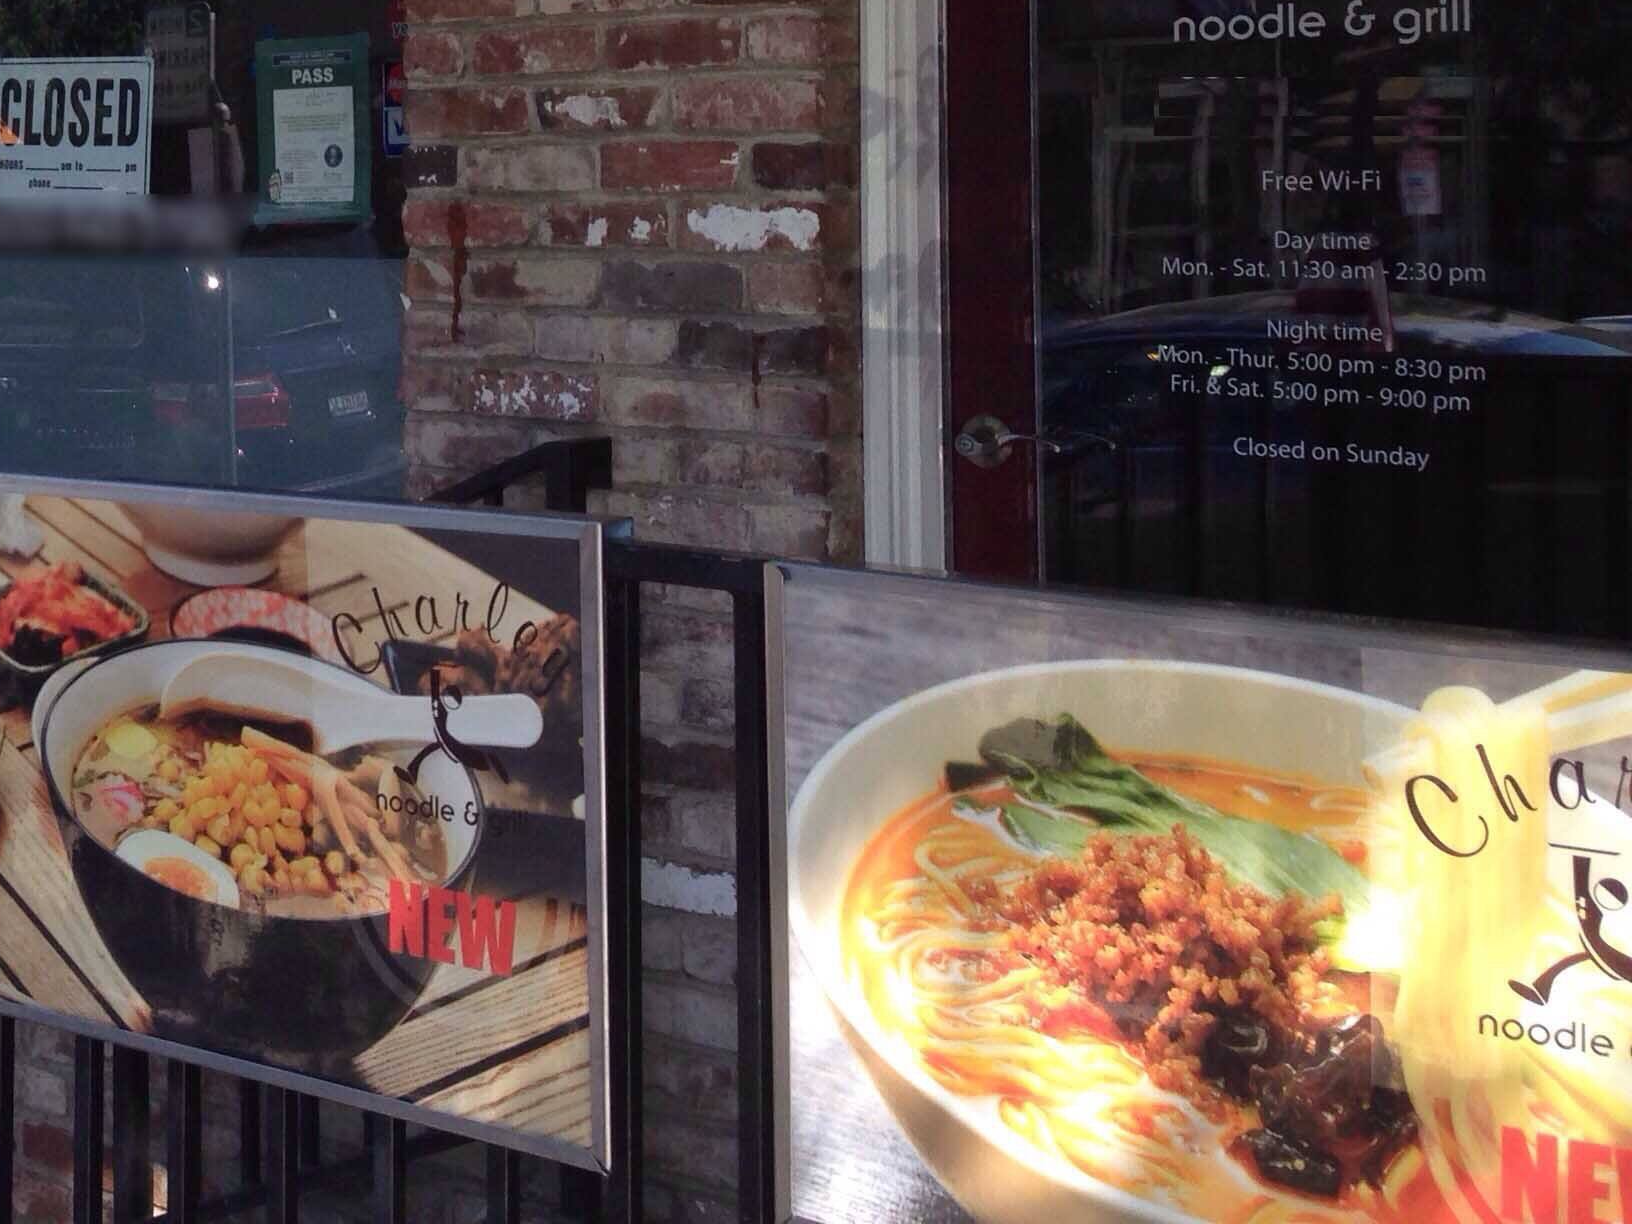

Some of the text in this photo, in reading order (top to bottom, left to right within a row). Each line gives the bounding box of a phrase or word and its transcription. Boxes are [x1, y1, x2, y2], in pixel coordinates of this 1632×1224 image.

[1173, 3, 1326, 42] noodle
[1344, 0, 1375, 35] &
[291, 67, 335, 85] PASS
[0, 78, 141, 147] CLOSED
[1262, 170, 1381, 192] Free Wi-Fi
[1274, 230, 1371, 254] Day time
[1161, 256, 1214, 276] Mon.
[1233, 258, 1270, 278] Sat.
[1279, 260, 1335, 279] 11:30
[1341, 264, 1375, 280] am
[1395, 262, 1442, 282] 2:30
[1448, 266, 1487, 286] pm
[1267, 319, 1384, 345] Night time
[1158, 344, 1209, 365] Mon.
[1226, 347, 1280, 370] Thur.
[1287, 352, 1332, 373] 5:00
[1338, 357, 1375, 378] pm
[1395, 359, 1442, 379] 8:30
[1448, 364, 1487, 385] pm
[1170, 374, 1201, 394] Fri.
[1206, 376, 1222, 395] &
[1226, 378, 1265, 399] Sat.
[1272, 380, 1318, 402] 5:00
[1324, 386, 1360, 407] pm
[1379, 388, 1427, 410] 9:00
[1433, 394, 1471, 415] pm
[1233, 437, 1431, 473] Closed on Sunday
[375, 793, 455, 824] noodle
[464, 801, 482, 826] &
[388, 877, 517, 975] NEW
[1478, 1013, 1614, 1057] noodle
